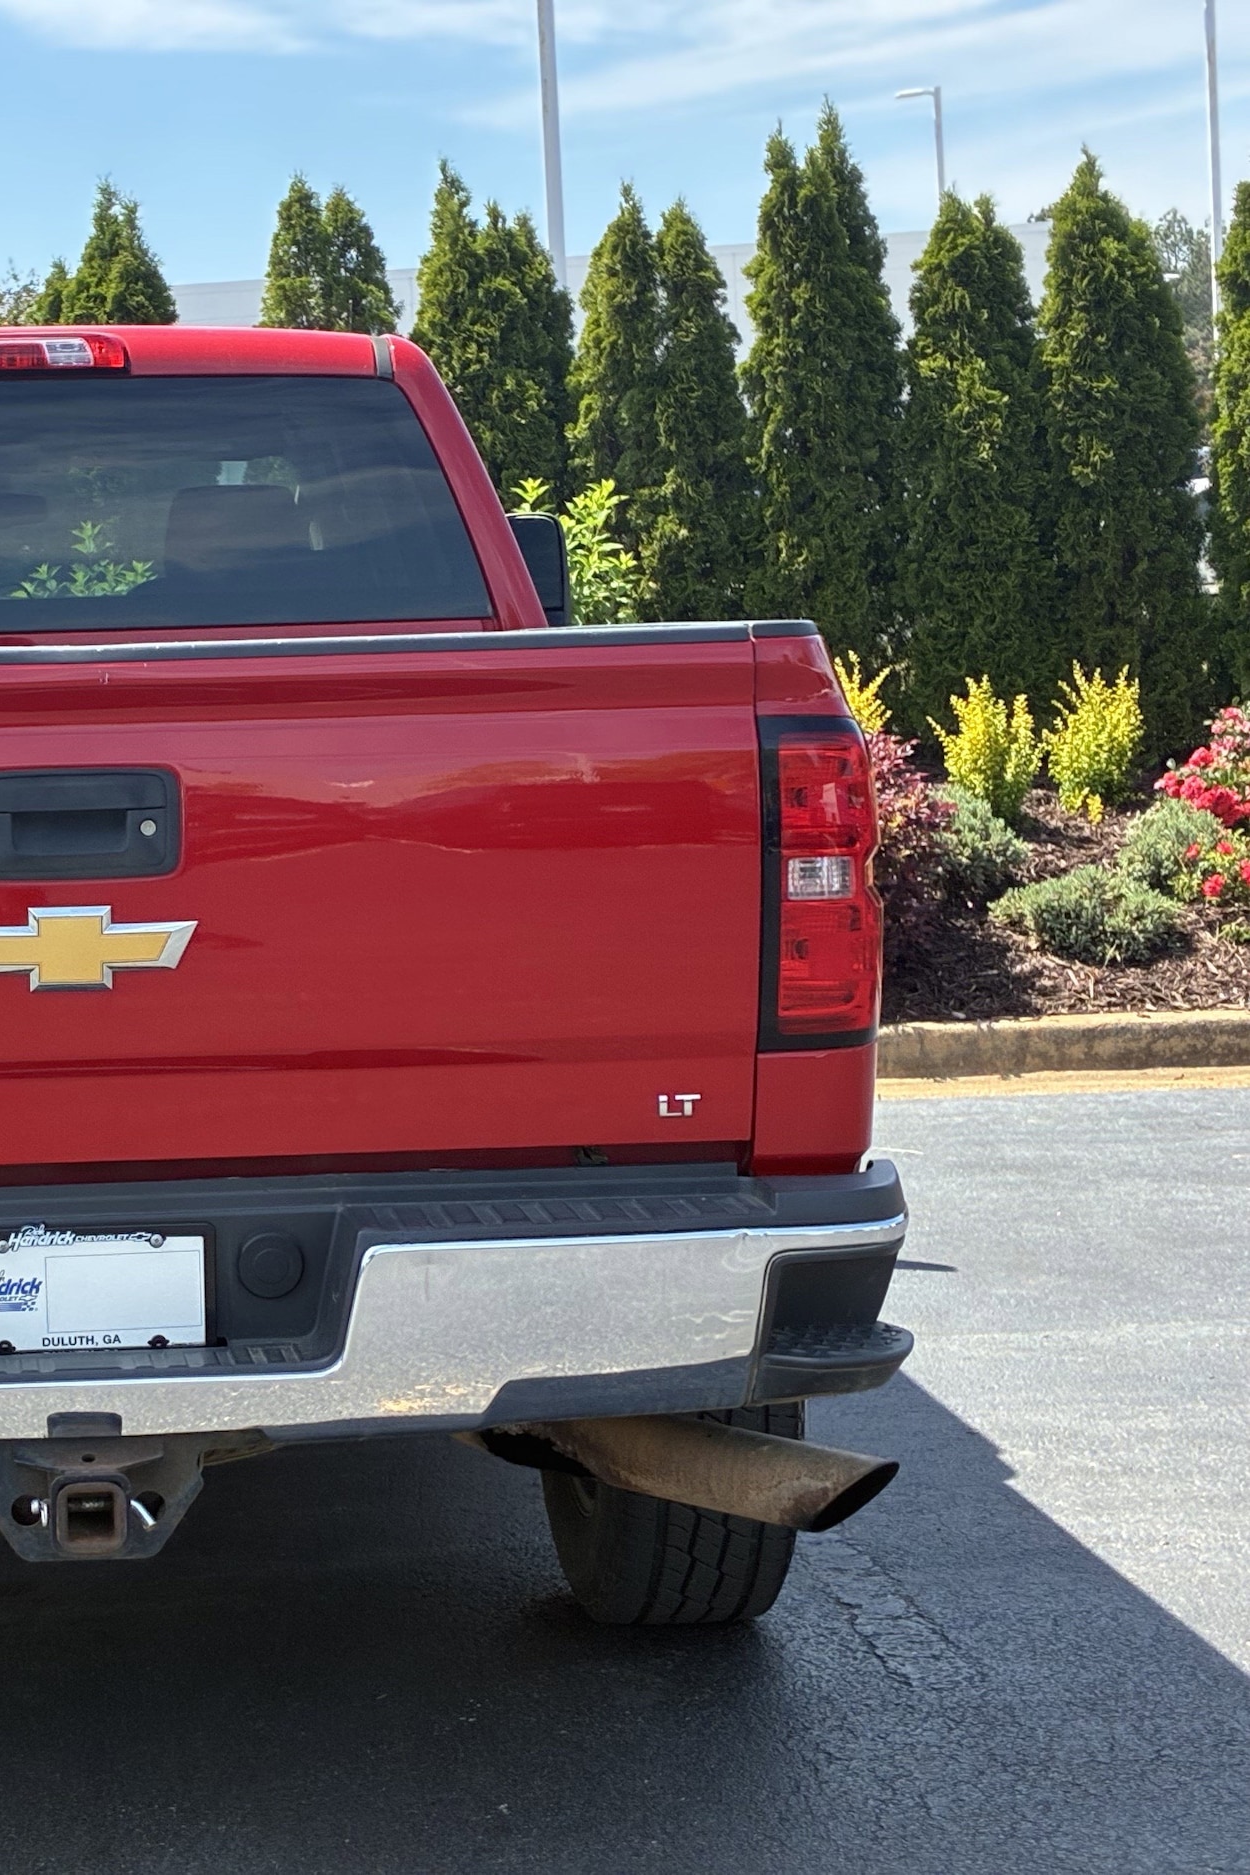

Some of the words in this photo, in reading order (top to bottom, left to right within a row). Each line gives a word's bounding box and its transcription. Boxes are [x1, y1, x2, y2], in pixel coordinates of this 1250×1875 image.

[658, 1093, 702, 1117] LT
[9, 1231, 76, 1251] Hendrick
[75, 1234, 130, 1242] CHEVROLET
[42, 1335, 99, 1347] DULUTH,
[102, 1334, 122, 1345] GA
